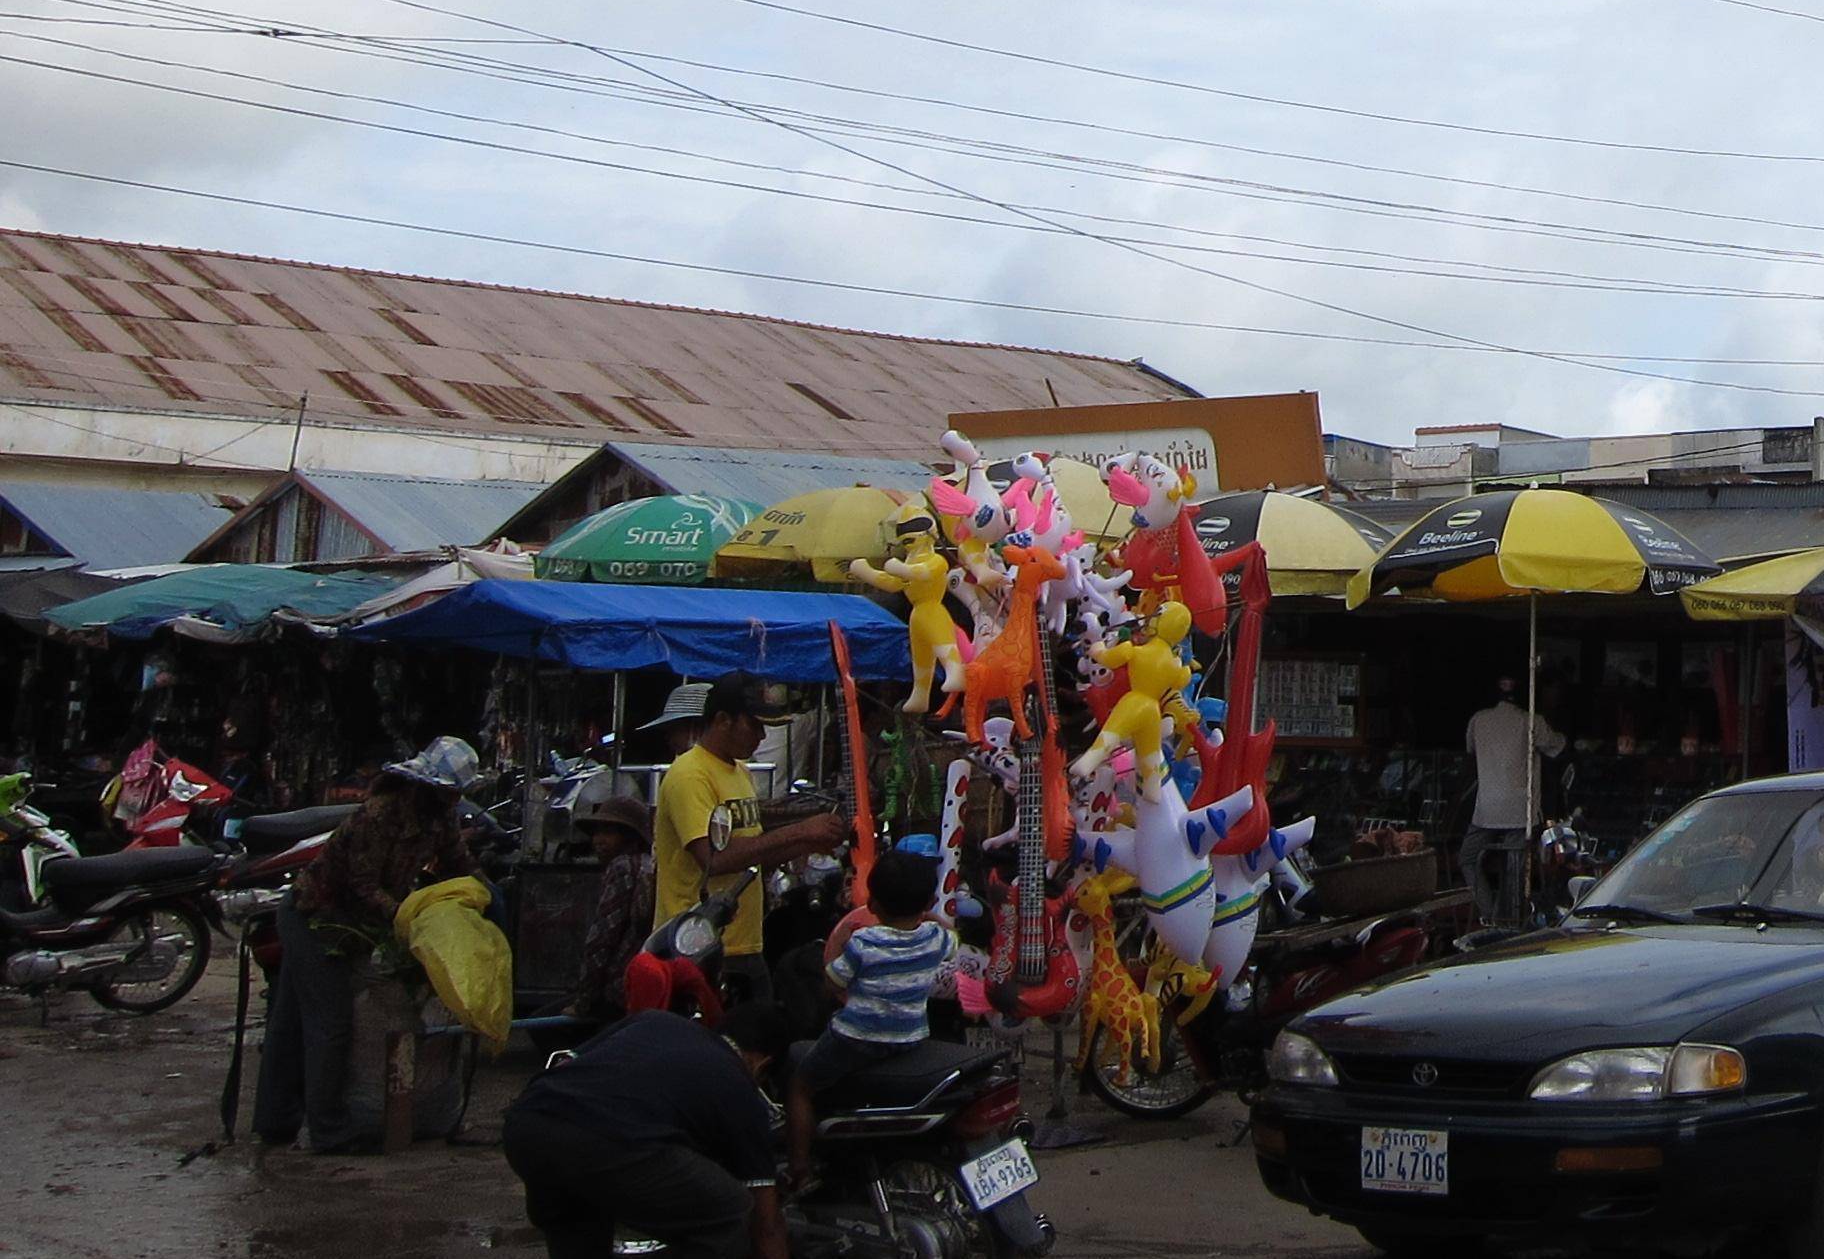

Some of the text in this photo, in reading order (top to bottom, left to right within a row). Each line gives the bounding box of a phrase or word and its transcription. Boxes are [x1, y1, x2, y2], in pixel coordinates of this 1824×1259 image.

[624, 527, 705, 545] Smart
[1418, 530, 1478, 546] Beeline
[609, 562, 697, 577] 069 070
